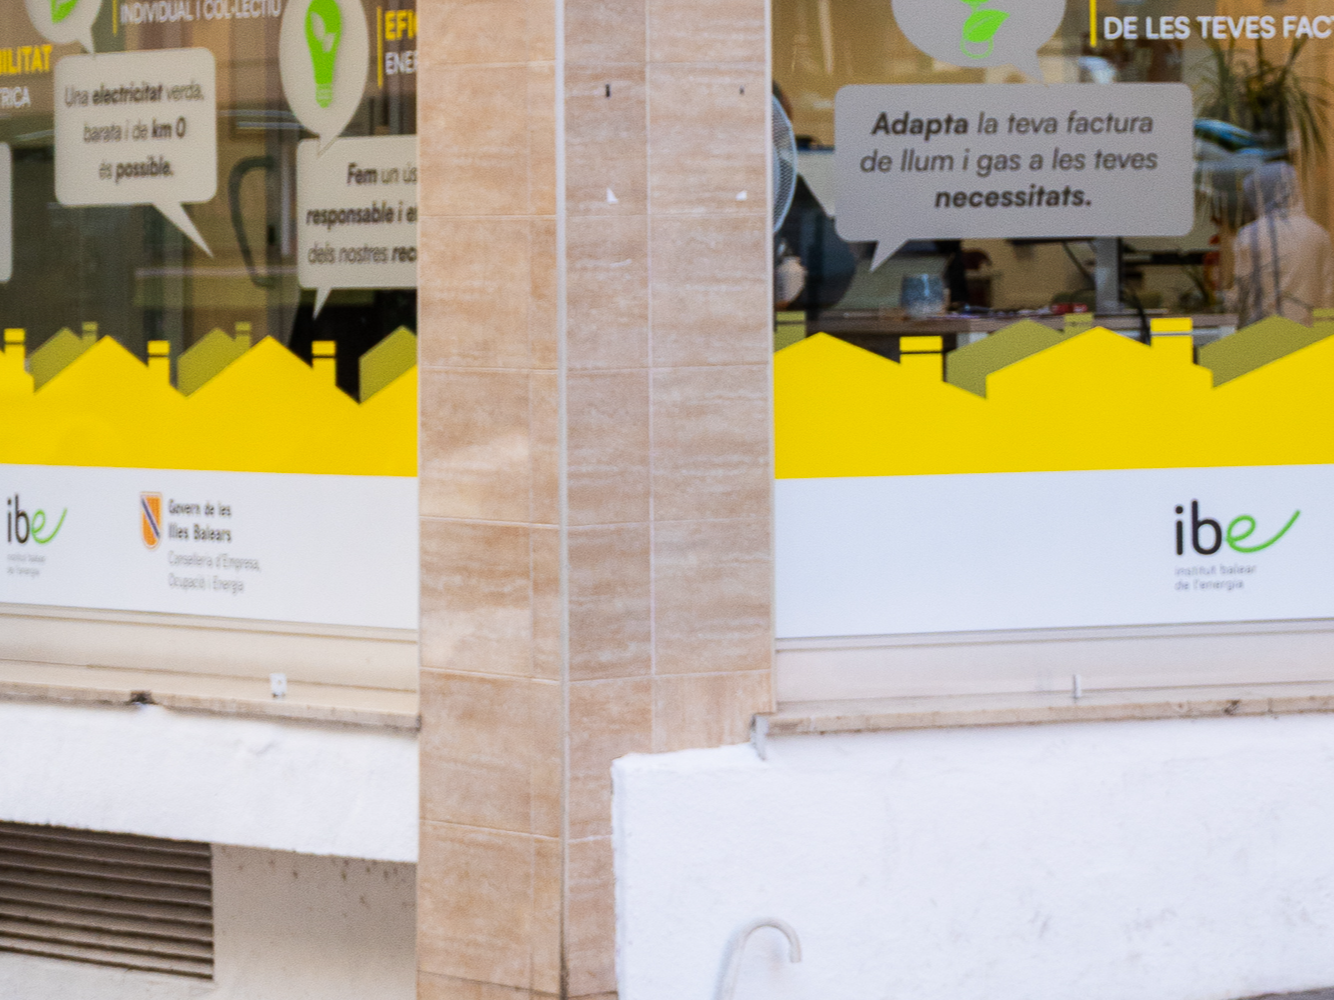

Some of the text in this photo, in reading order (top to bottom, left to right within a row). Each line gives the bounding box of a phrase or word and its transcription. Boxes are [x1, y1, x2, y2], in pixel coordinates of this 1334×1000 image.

[120, 0, 194, 24] INDIVIDUAL
[385, 9, 418, 40] EFI
[1103, 16, 1138, 39] DE
[1146, 16, 1190, 39] LES
[1196, 15, 1276, 39] TEVES
[92, 81, 163, 106] electricitat
[152, 116, 172, 139] km
[871, 110, 1154, 142] Adapta la teva factura
[347, 162, 378, 186] Fem
[860, 147, 1158, 178] de llum i gas a les teves
[934, 184, 1092, 208] necessitats.
[306, 200, 394, 232] responsable
[7, 492, 68, 545] ibe
[168, 498, 201, 515] Govern
[204, 500, 215, 516] de
[193, 523, 231, 543] Balears
[1175, 499, 1301, 555] ibe
